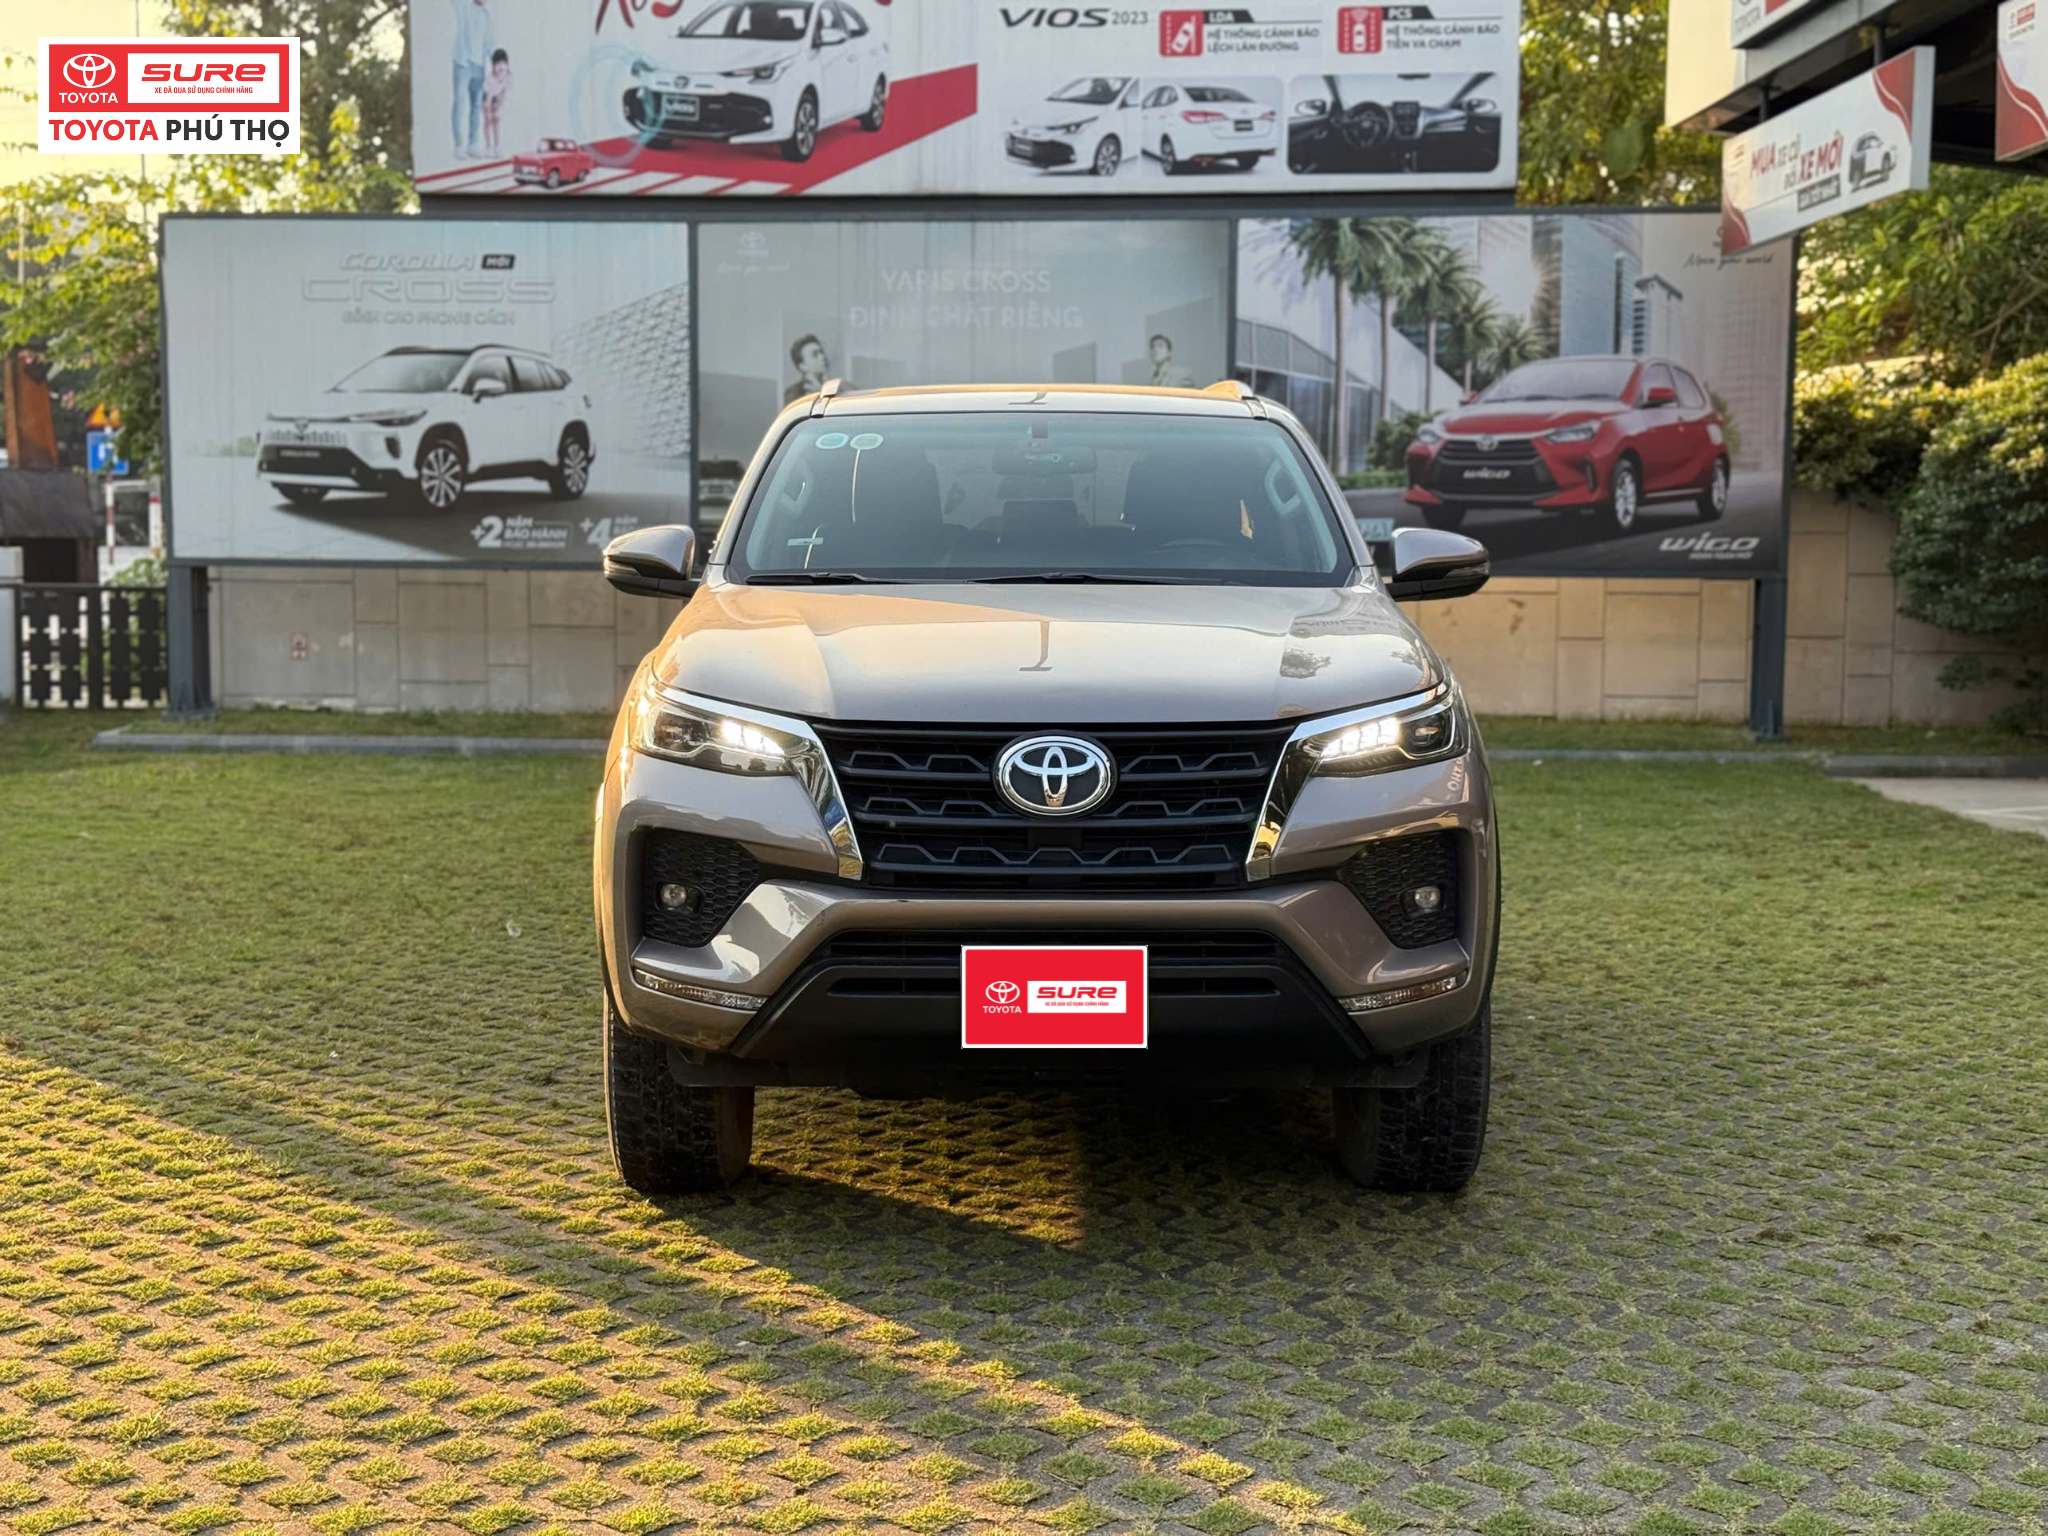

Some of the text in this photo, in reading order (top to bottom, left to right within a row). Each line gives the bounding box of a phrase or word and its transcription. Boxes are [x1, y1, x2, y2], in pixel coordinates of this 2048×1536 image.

[1000, 8, 1149, 28] VIOS 2023
[1208, 11, 1235, 22] LDA
[1749, 142, 1776, 179] MUA
[340, 253, 477, 272] COROLLA
[302, 276, 556, 304] CROSS
[881, 268, 1052, 293] YARIS CROSS
[1001, 301, 1084, 329] RIÊNG
